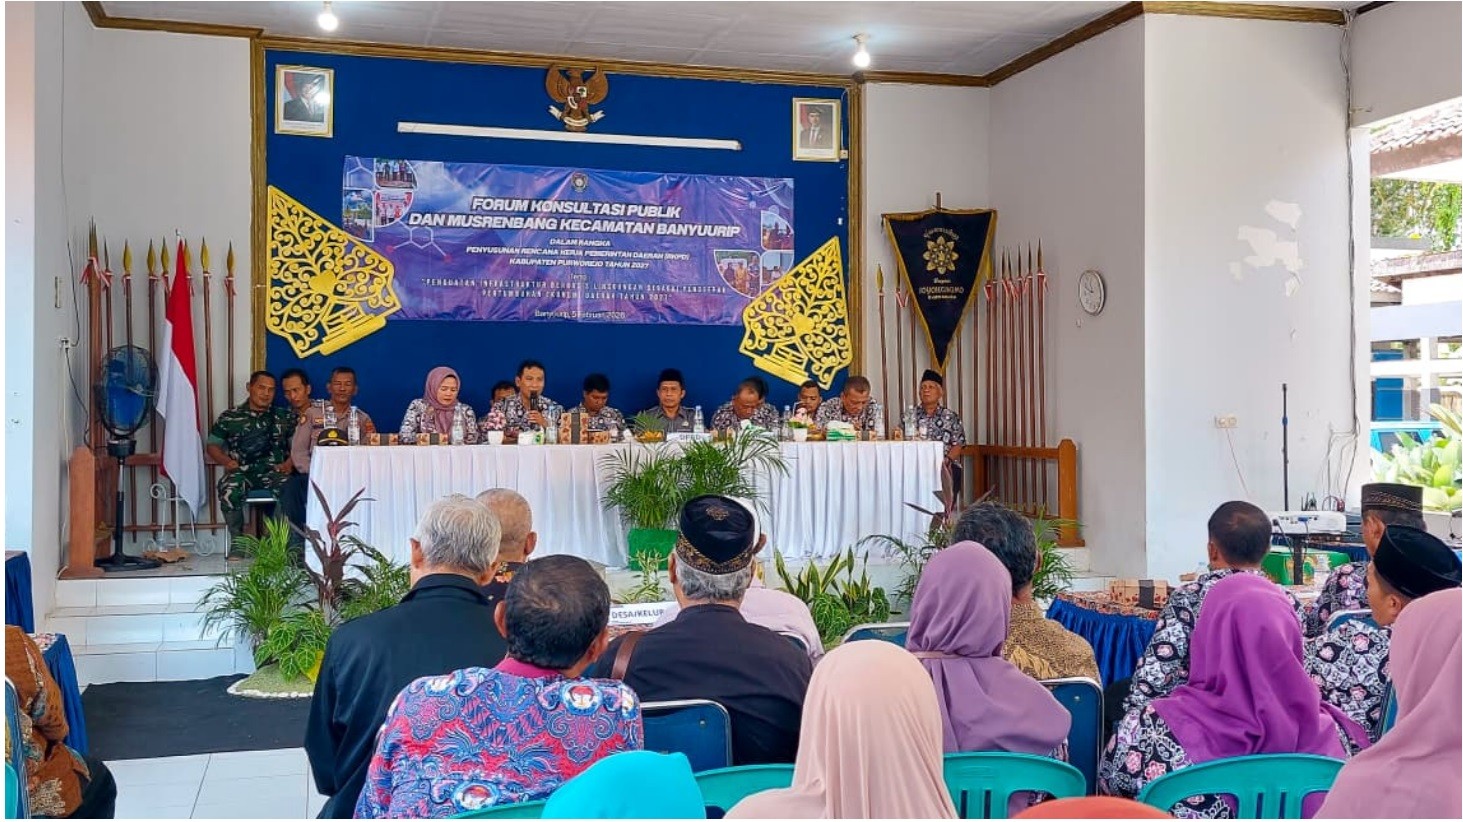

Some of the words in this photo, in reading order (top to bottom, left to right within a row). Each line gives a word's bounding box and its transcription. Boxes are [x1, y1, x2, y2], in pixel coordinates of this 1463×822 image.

[472, 197, 528, 212] FORUM
[530, 199, 625, 216] KONSULTASI
[626, 204, 682, 219] PUBLIK
[408, 213, 445, 226] DAN
[447, 214, 558, 231] MUSRENBANG
[559, 218, 655, 235] KECAMATAN
[656, 223, 742, 238] BANYUURIP
[549, 238, 578, 246] DALAM
[579, 239, 611, 247] RANGKA
[466, 246, 520, 255] PENYUSUNAN
[521, 247, 559, 256] RENCANA
[560, 248, 583, 257] KERJA
[632, 252, 664, 260] DAERAH
[509, 257, 557, 267] KABUPATEN
[557, 259, 604, 268] PURWOREJO
[605, 260, 631, 269] TAHUN
[631, 262, 650, 270] 2027
